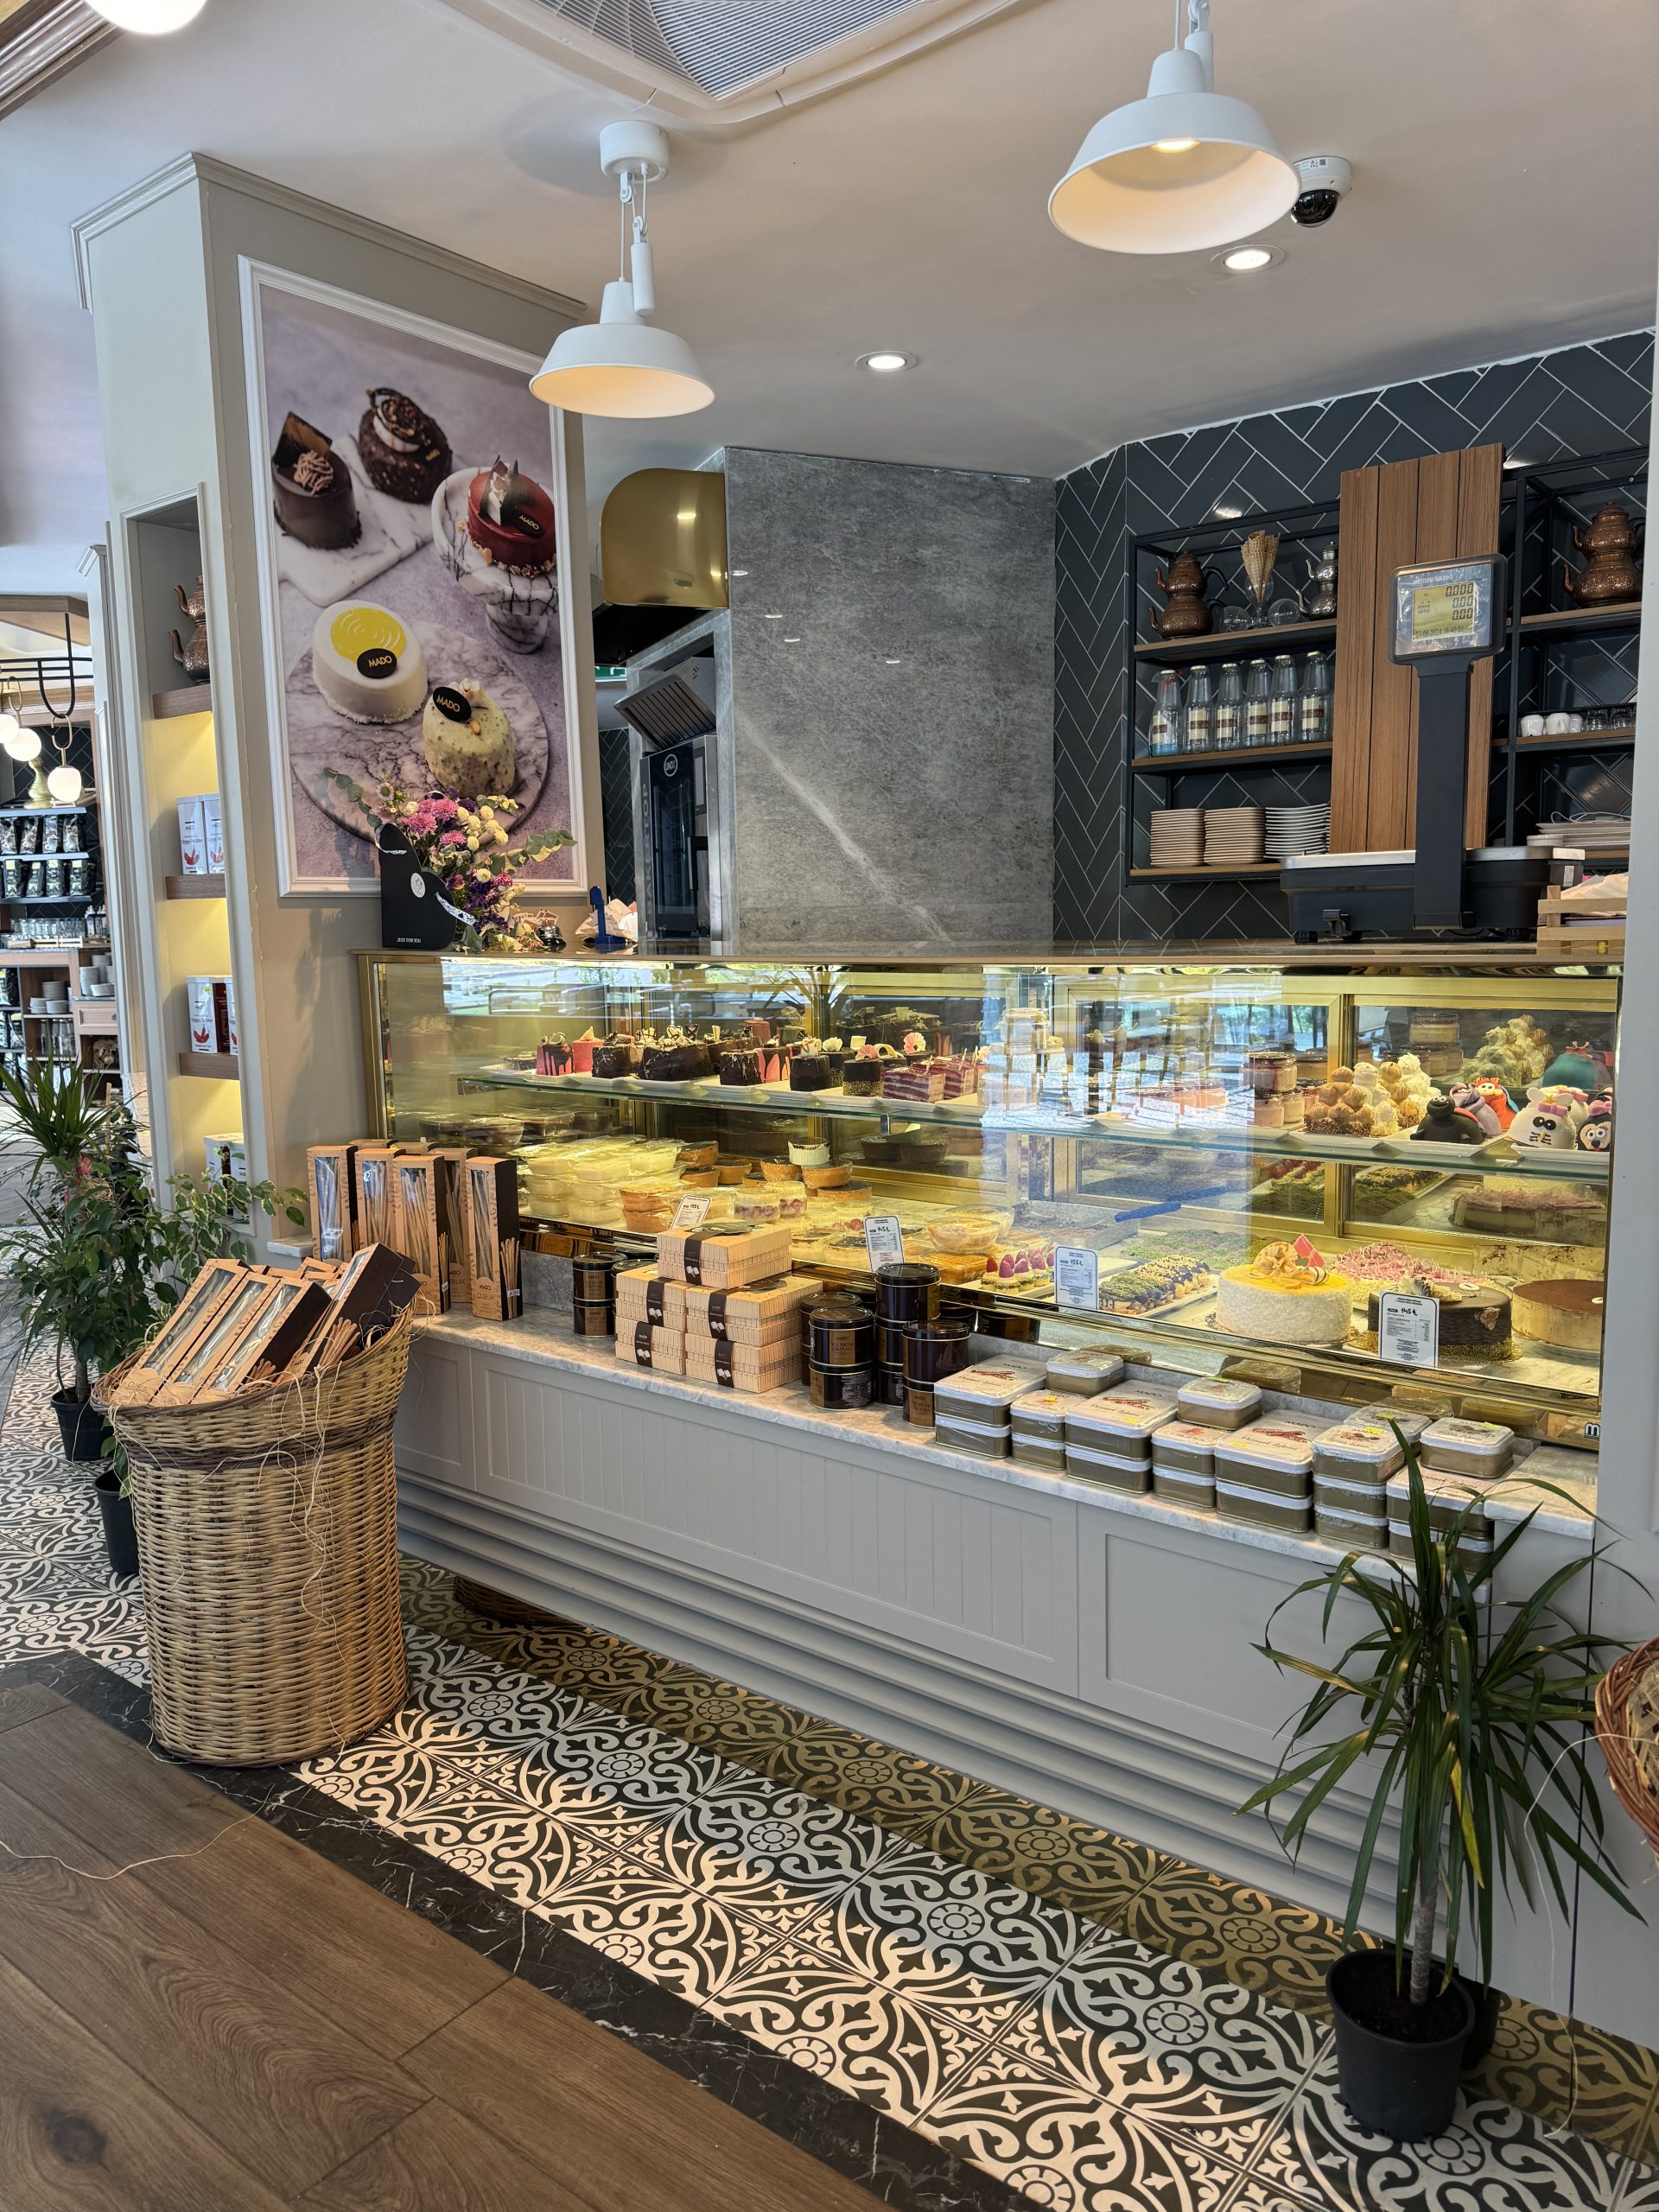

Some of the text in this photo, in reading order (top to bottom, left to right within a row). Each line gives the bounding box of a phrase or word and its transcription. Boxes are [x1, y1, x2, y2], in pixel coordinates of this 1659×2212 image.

[519, 515, 539, 530] MADO
[368, 655, 392, 667] MADO
[436, 694, 461, 713] MADO
